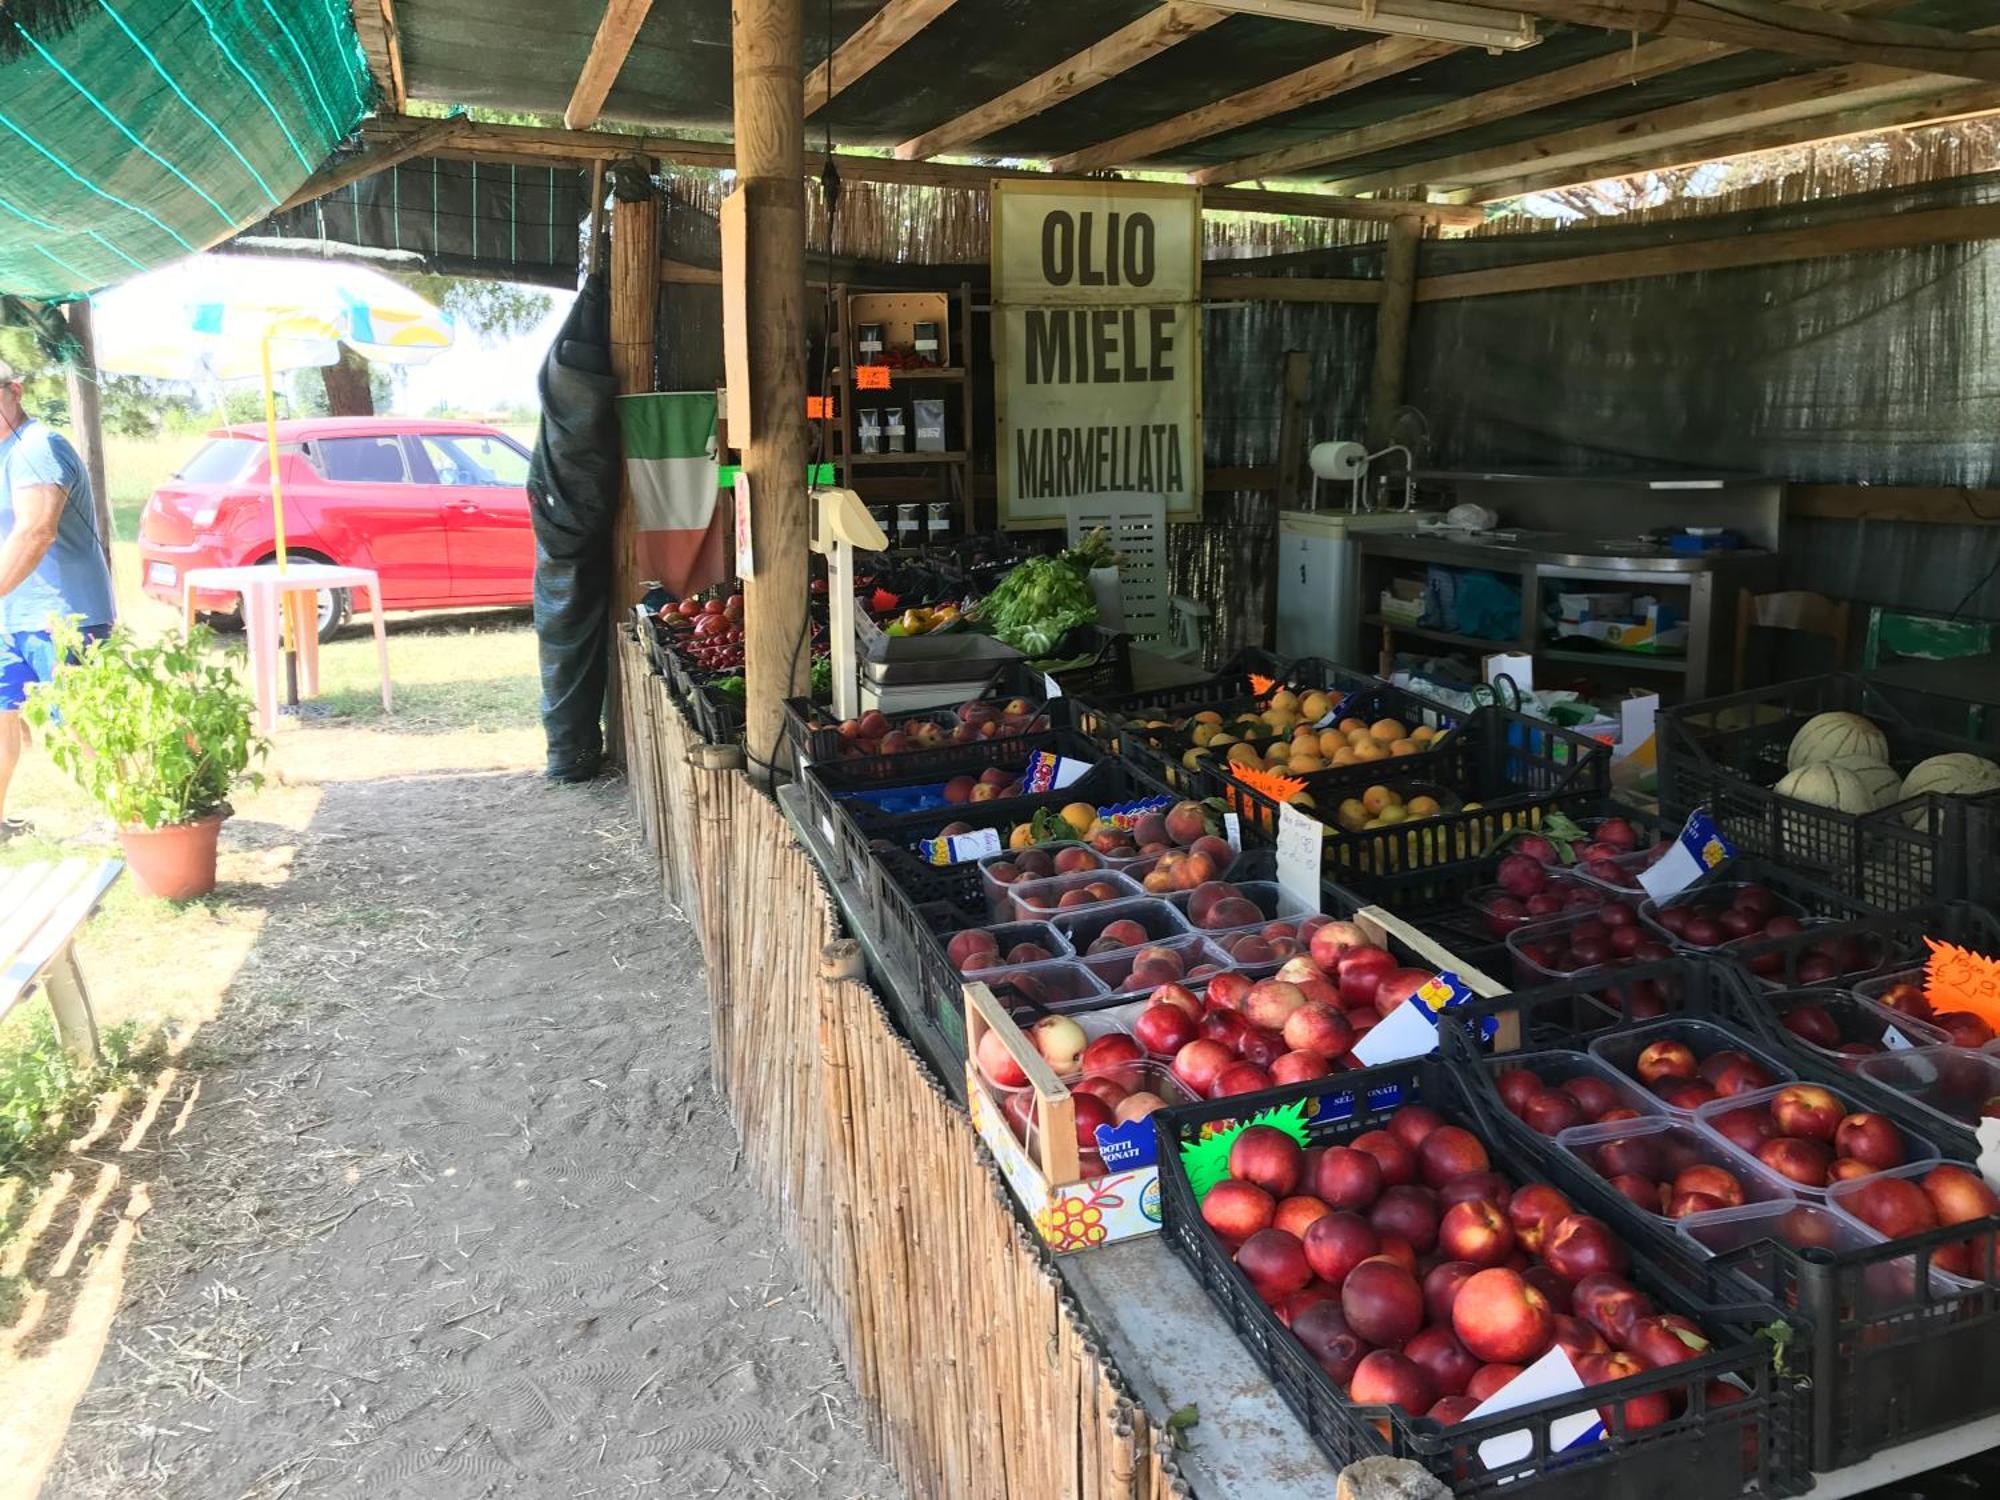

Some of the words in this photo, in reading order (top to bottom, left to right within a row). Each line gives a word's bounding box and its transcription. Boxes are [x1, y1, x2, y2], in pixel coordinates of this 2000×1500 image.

[1041, 210, 1155, 287] OLIO
[1025, 309, 1175, 384] MIELE
[1016, 424, 1183, 499] MARMELLATA
